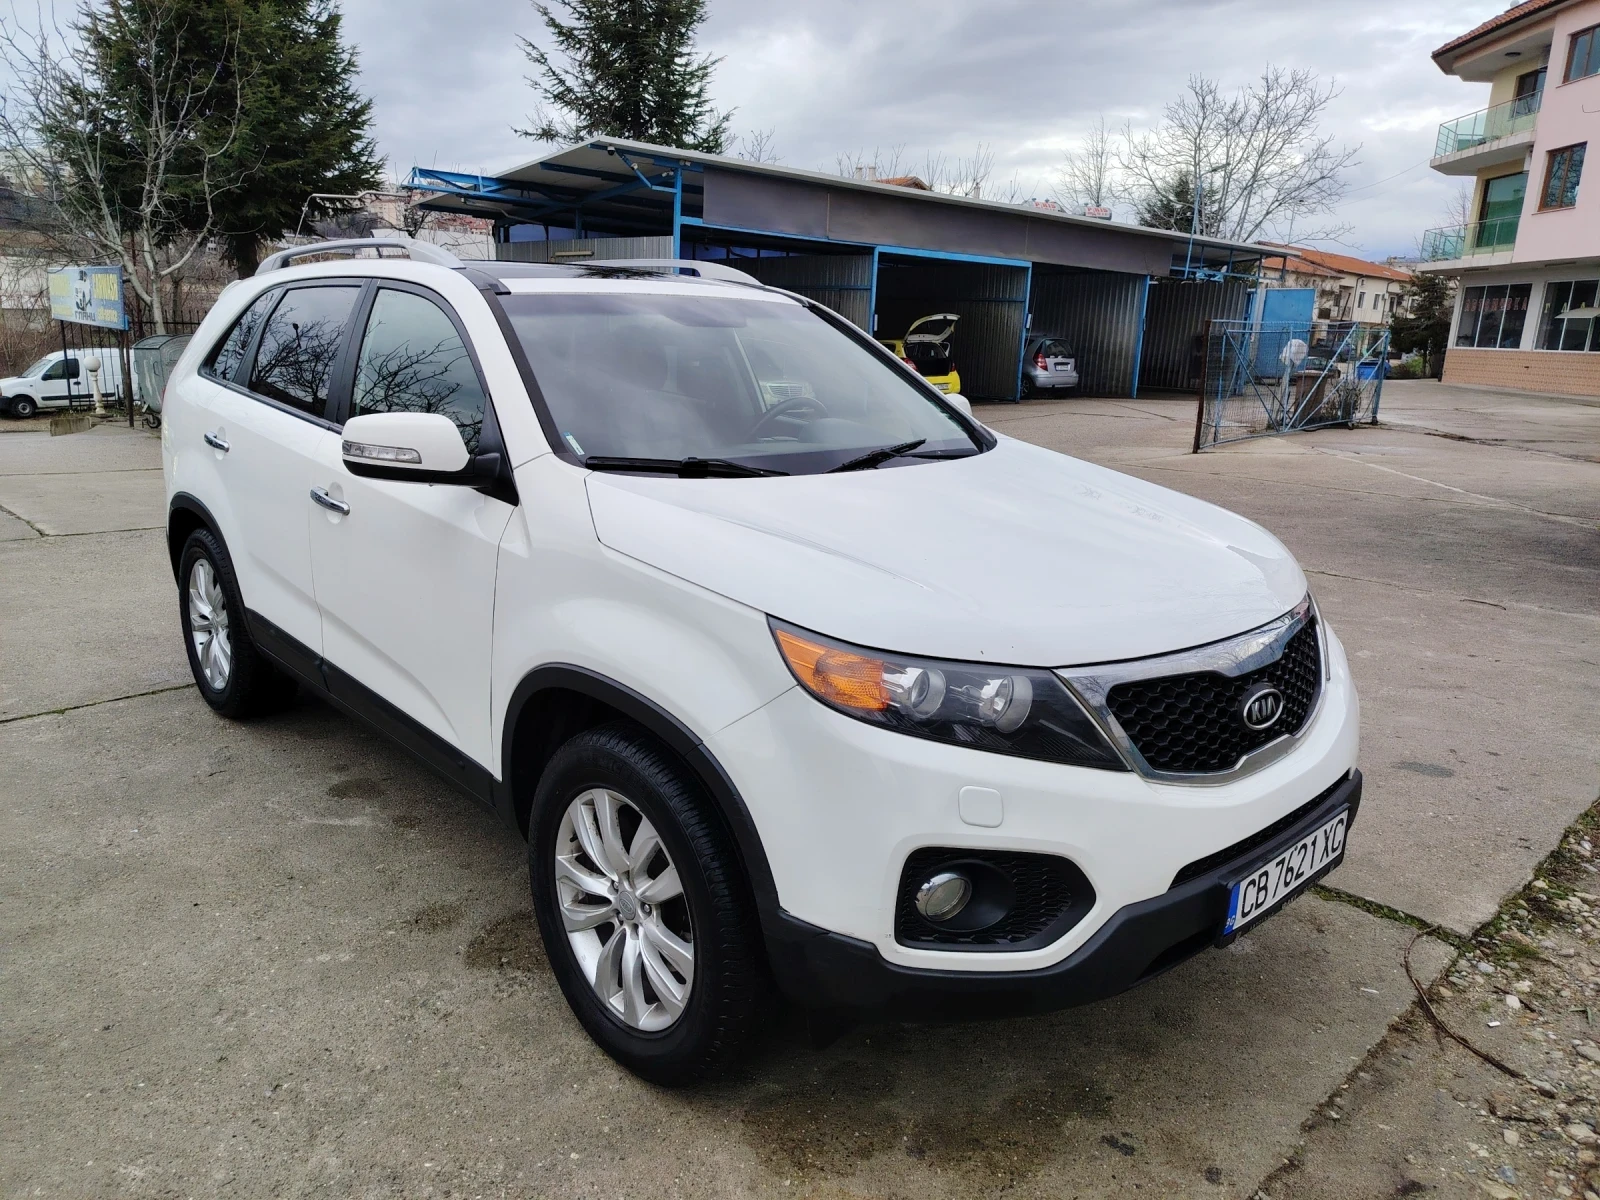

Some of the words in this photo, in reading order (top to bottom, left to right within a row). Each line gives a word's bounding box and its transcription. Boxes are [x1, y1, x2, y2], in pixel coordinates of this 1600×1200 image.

[1251, 695, 1277, 723] KIA
[1241, 869, 1270, 919] CB
[1272, 842, 1318, 899] 7621
[1319, 817, 1345, 864] XC
